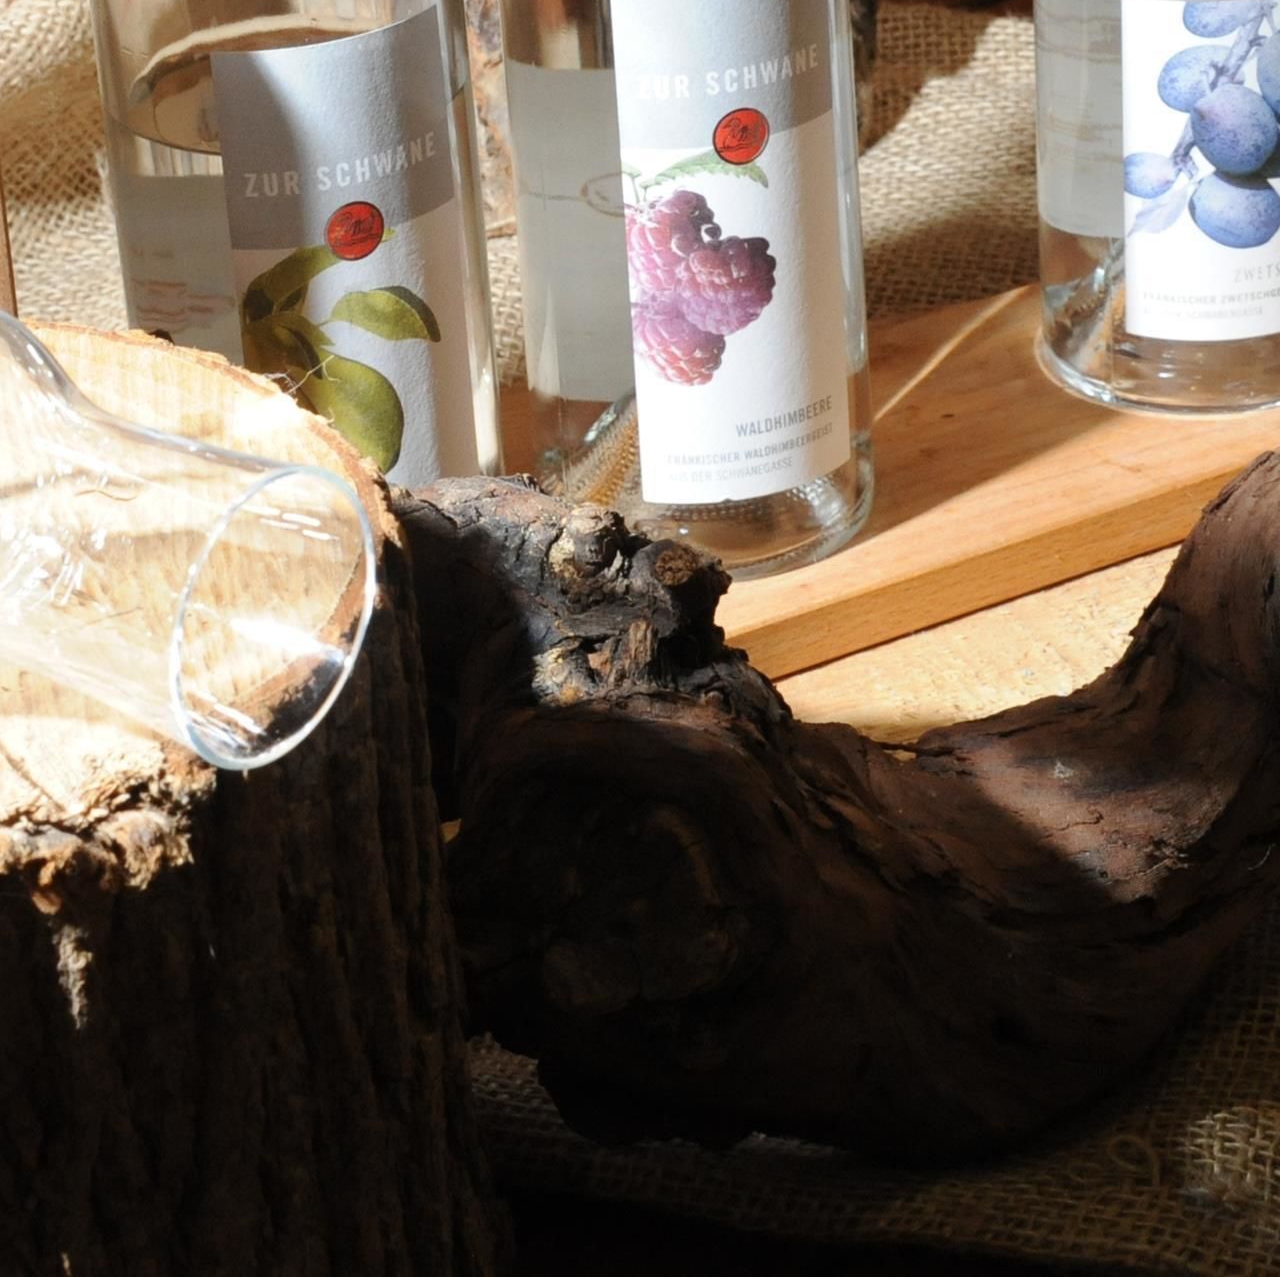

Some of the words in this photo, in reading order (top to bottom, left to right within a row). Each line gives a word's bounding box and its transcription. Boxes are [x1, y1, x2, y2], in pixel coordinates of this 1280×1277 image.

[638, 74, 690, 100] ZUR
[705, 43, 819, 95] SCHWANE
[244, 171, 300, 198] ZUR
[315, 132, 436, 191] SCHWANE
[736, 395, 833, 438] WALDHIMBEERE
[667, 451, 740, 466] FRÄNKISCHER
[744, 422, 833, 460] WALDHIMBEERGEIST
